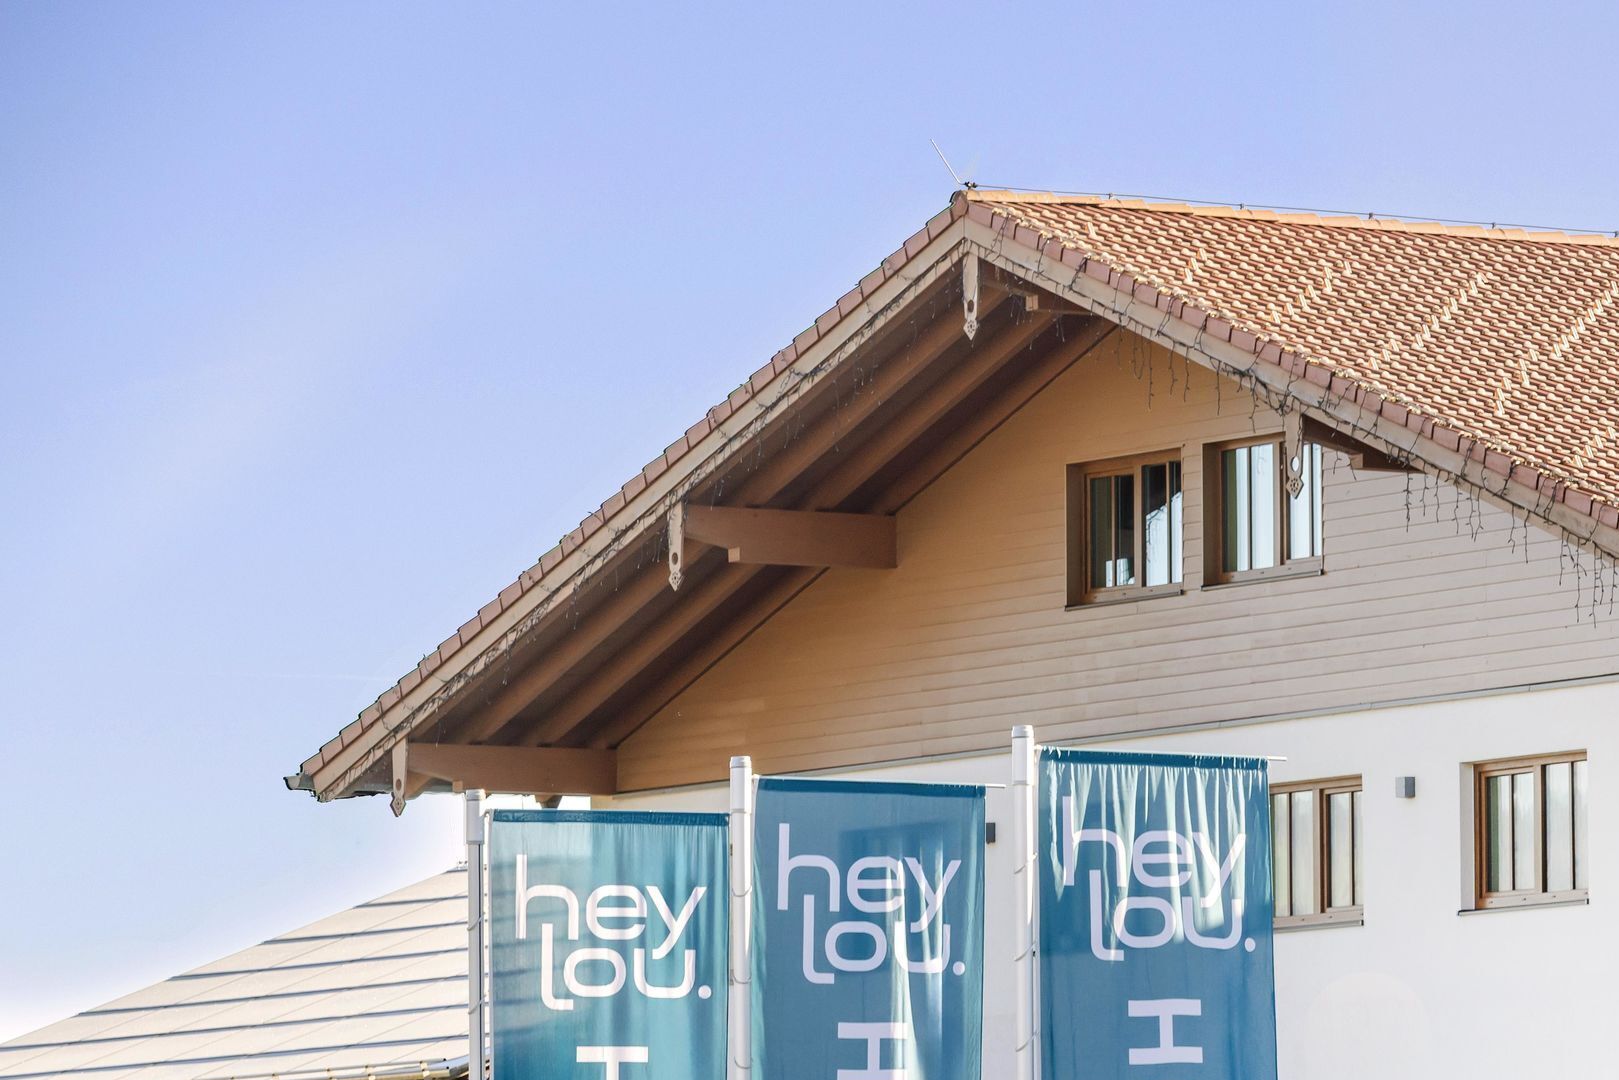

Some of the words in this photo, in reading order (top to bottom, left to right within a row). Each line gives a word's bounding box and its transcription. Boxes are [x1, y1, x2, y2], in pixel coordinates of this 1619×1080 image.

[777, 822, 962, 936] hey
[1062, 796, 1246, 909] hey
[515, 853, 707, 960] hey
[802, 893, 967, 984] lou.
[1089, 868, 1256, 961] lou.
[541, 922, 712, 1011] lou.
